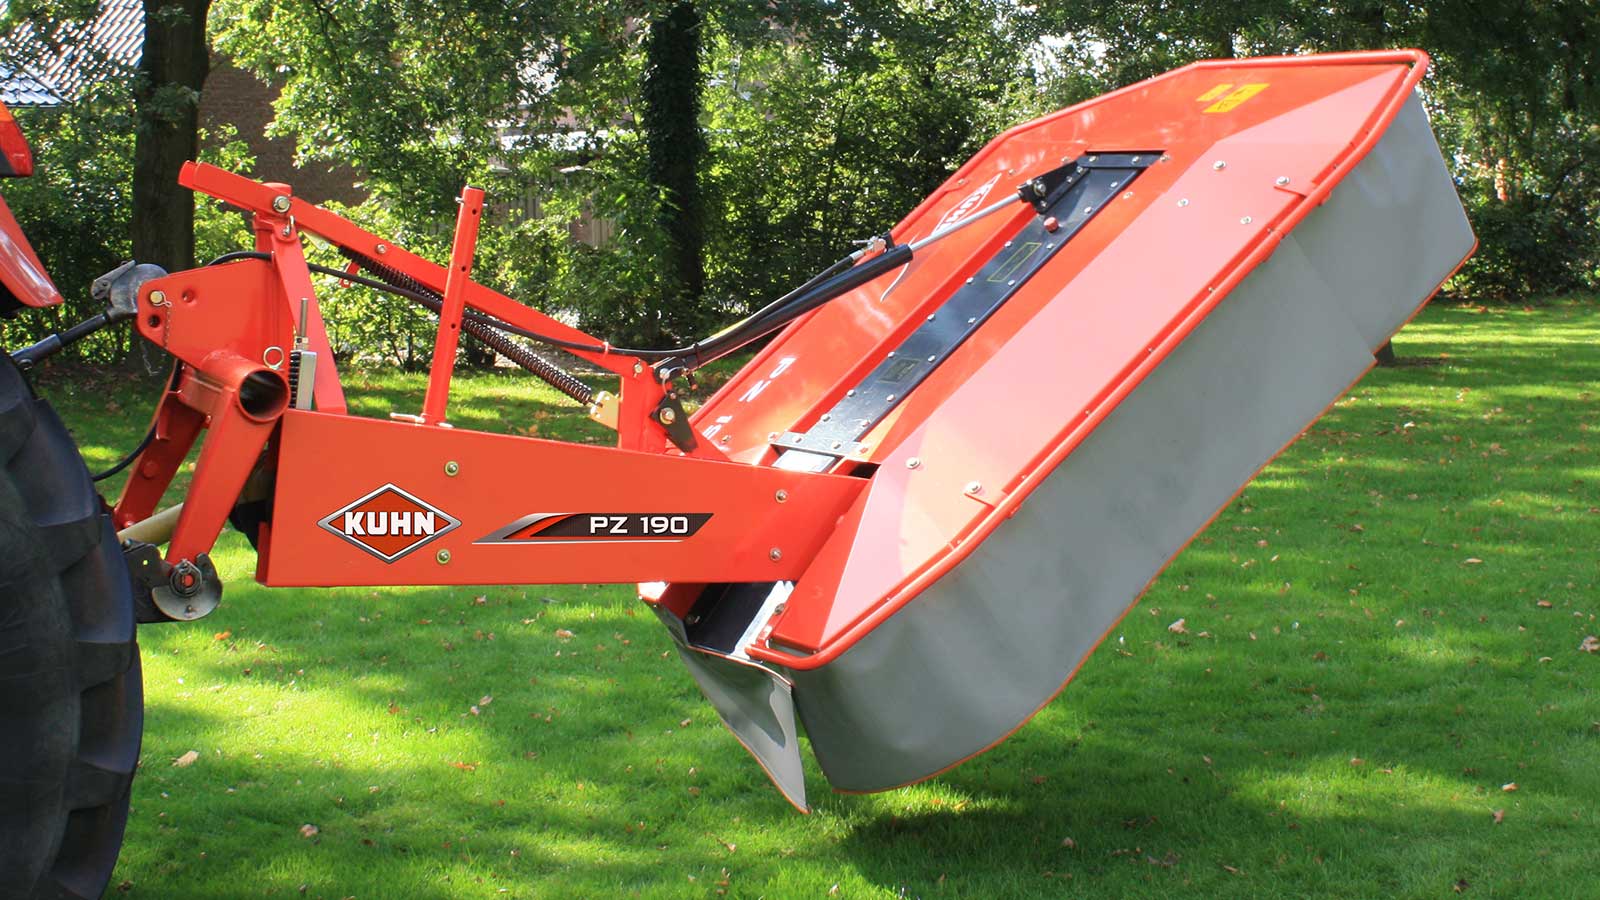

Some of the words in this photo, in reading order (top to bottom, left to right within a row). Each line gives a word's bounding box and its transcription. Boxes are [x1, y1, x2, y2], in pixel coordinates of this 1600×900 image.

[344, 511, 434, 535] KUHN
[590, 516, 628, 534] PZ
[640, 516, 688, 534] 190
